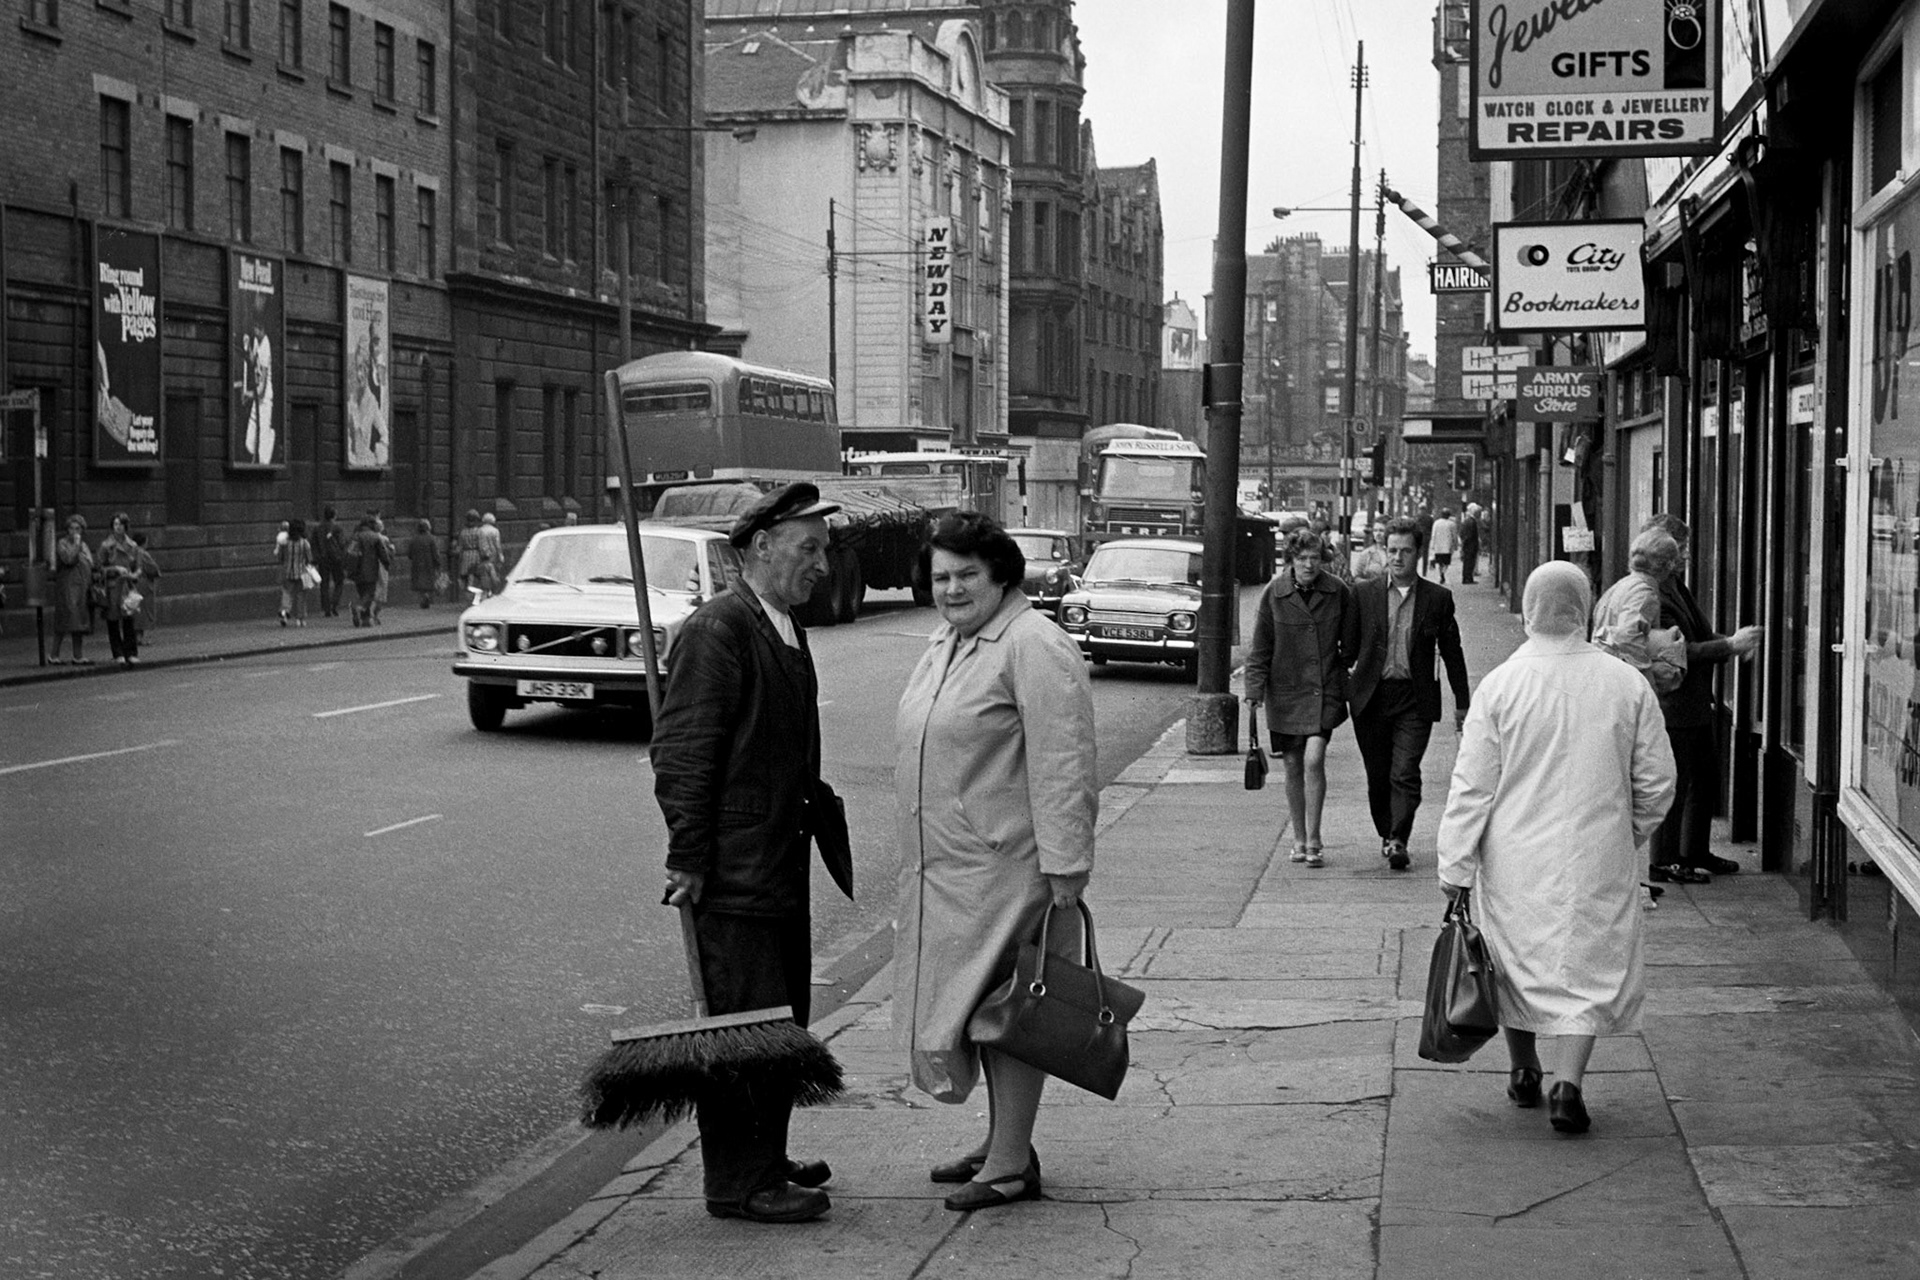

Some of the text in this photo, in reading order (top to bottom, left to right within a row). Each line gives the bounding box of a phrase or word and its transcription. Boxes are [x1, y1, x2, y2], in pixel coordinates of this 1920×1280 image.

[1551, 49, 1651, 78] GIFTS
[1484, 97, 1711, 118] WATCH CLOCK & JEWELLERY
[1507, 118, 1685, 143] REPAIRS
[1566, 242, 1626, 272] City
[119, 286, 156, 316] Yellow
[1503, 291, 1640, 313] Bookmakers
[121, 314, 157, 342] pages
[1532, 371, 1583, 385] ARMY
[1522, 384, 1592, 398] SURPLUS
[1534, 397, 1578, 413] Store
[1121, 526, 1168, 536] ERF
